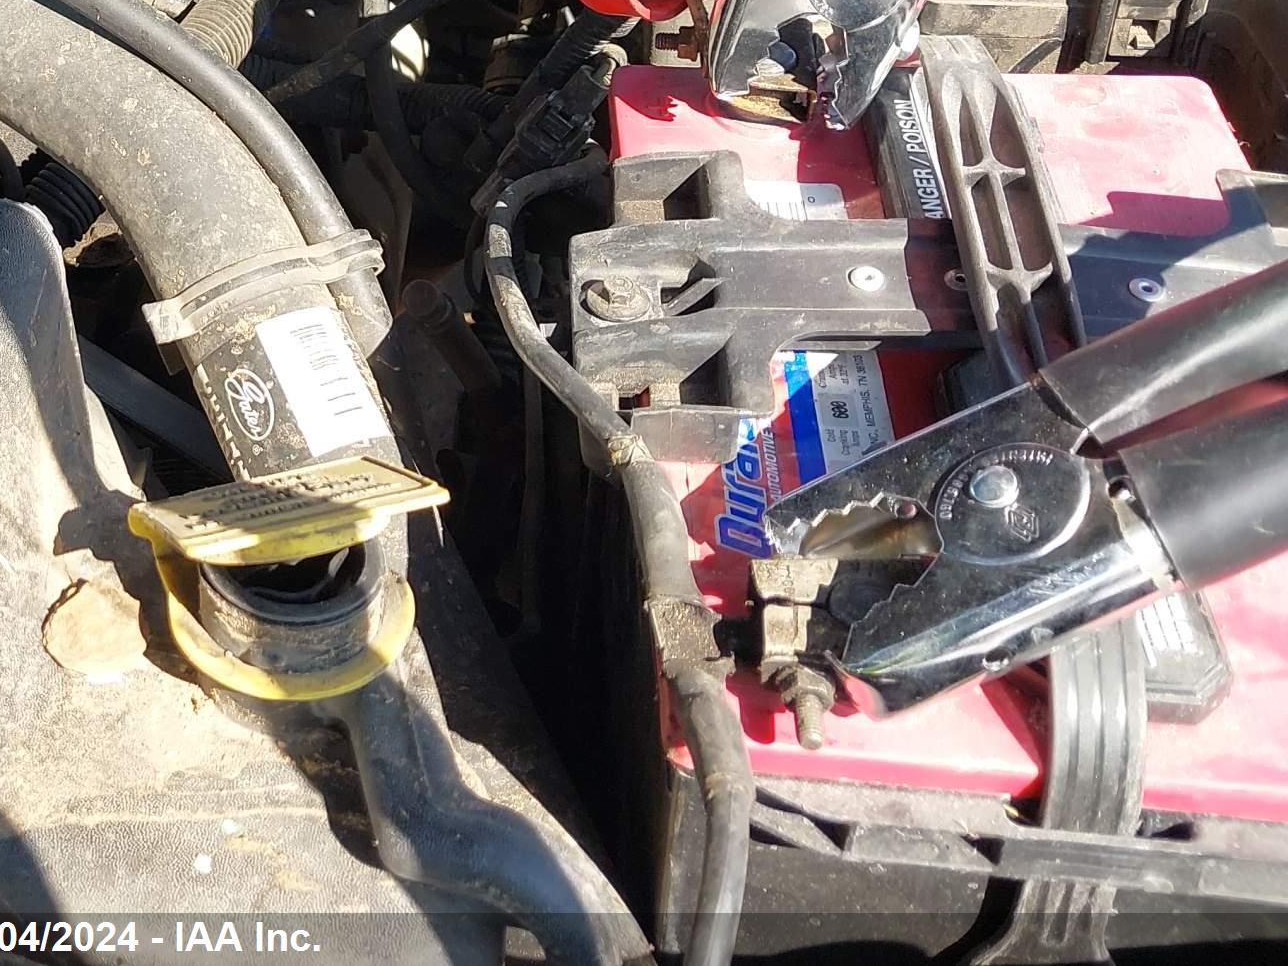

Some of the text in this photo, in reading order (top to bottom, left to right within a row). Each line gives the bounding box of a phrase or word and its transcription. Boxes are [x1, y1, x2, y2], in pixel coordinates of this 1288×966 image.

[894, 98, 929, 153] POISON
[913, 167, 946, 219] ANGER
[830, 400, 849, 420] 600
[761, 427, 782, 501] AUTOMOTIVE
